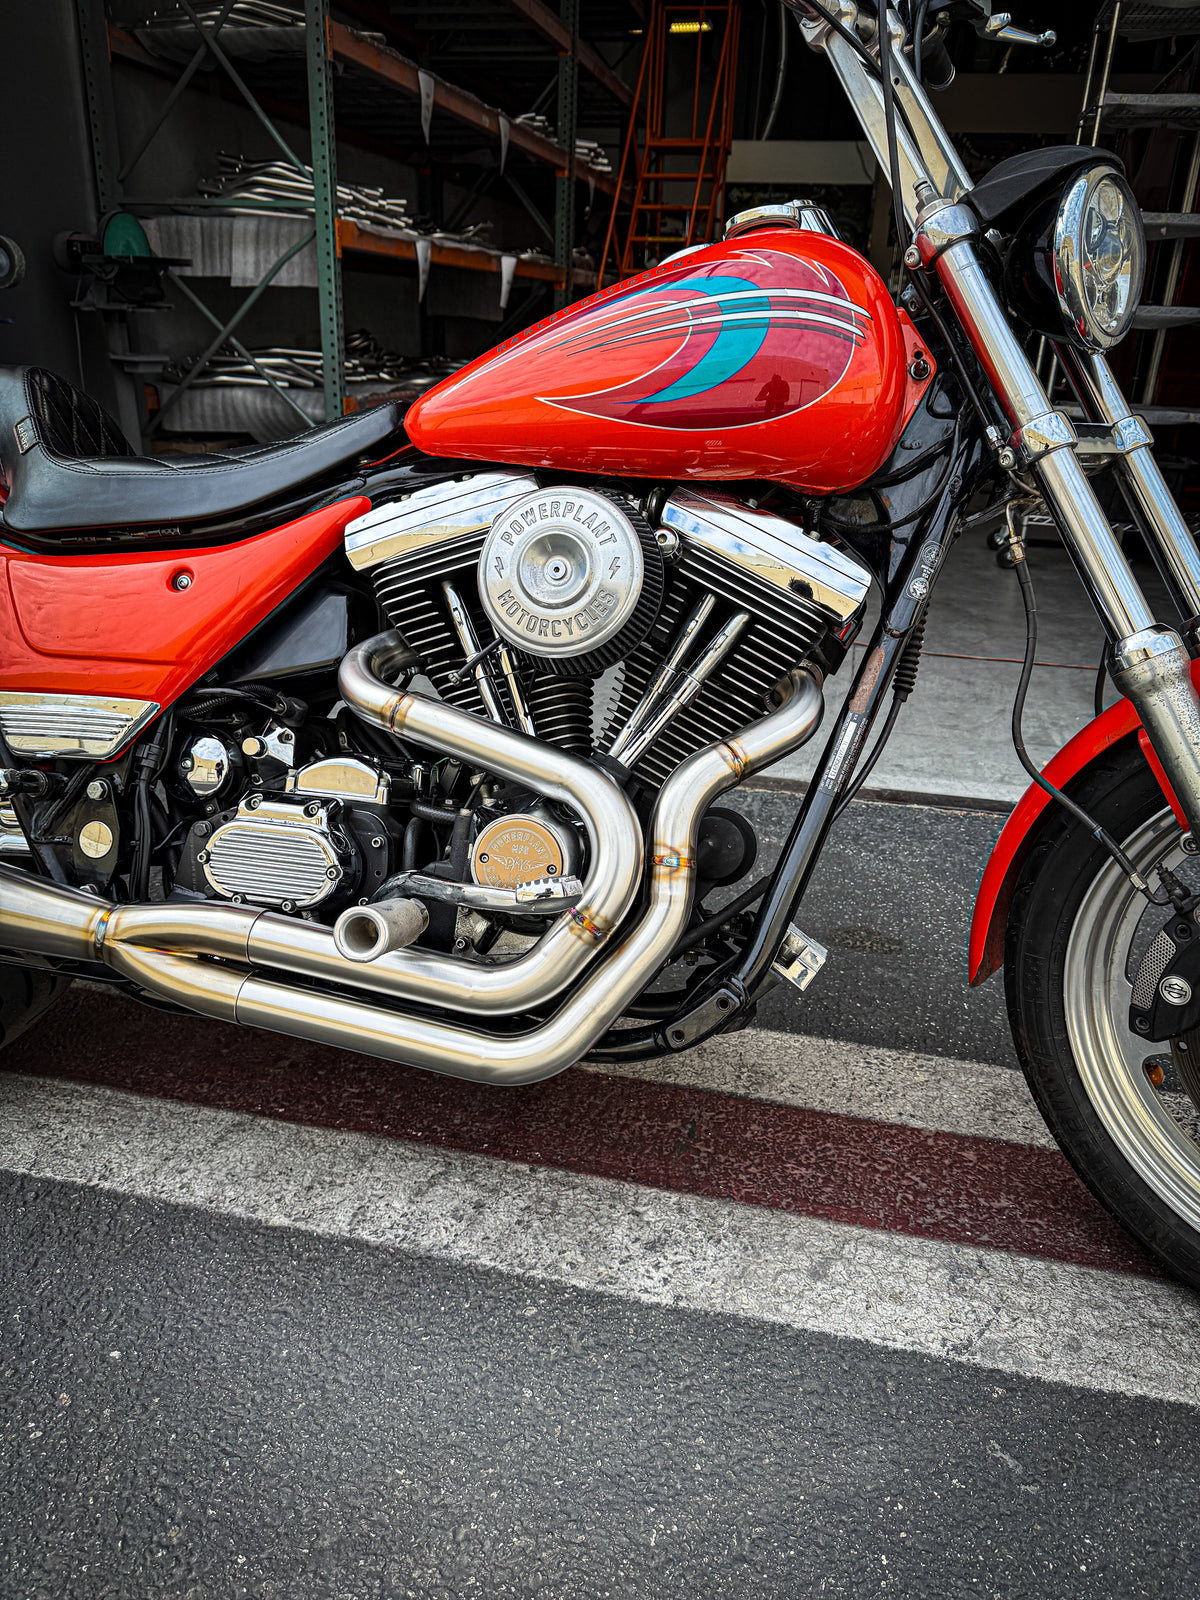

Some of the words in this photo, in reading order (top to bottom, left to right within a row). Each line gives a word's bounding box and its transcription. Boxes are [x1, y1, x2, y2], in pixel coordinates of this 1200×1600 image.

[501, 501, 618, 547] POWERPLANT
[497, 588, 616, 638] MOTORCYCLES
[491, 832, 548, 859] POWERPLANT
